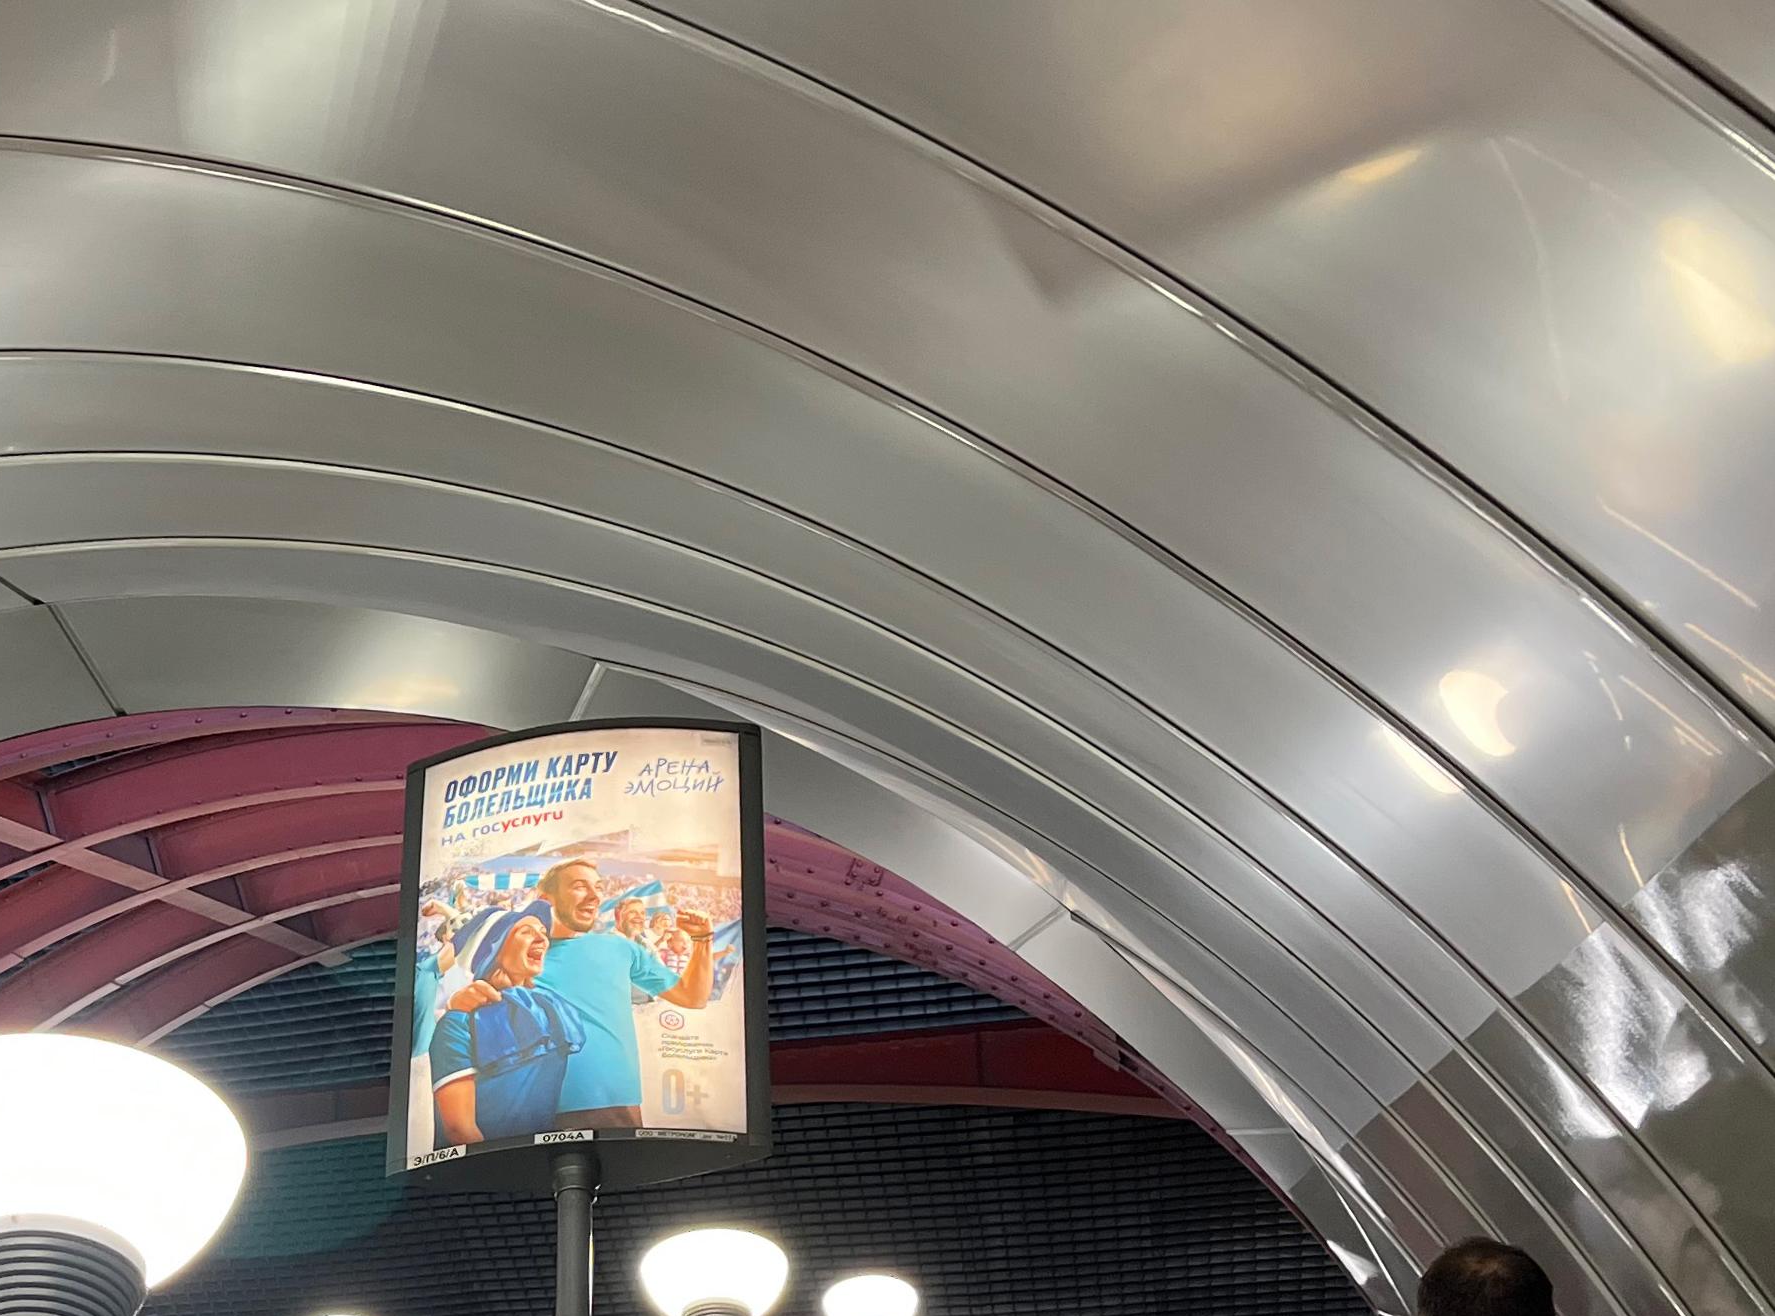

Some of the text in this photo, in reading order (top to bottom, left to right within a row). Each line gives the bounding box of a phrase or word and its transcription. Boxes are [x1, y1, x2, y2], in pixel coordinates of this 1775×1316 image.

[444, 751, 618, 803] ОФОРМИ КАРТУ
[624, 770, 725, 797] ЭМОЦИЙ
[638, 757, 710, 778] АРЕНА
[442, 777, 593, 829] БОЛЕЛЬЩИКА
[662, 1069, 709, 1115] 0+
